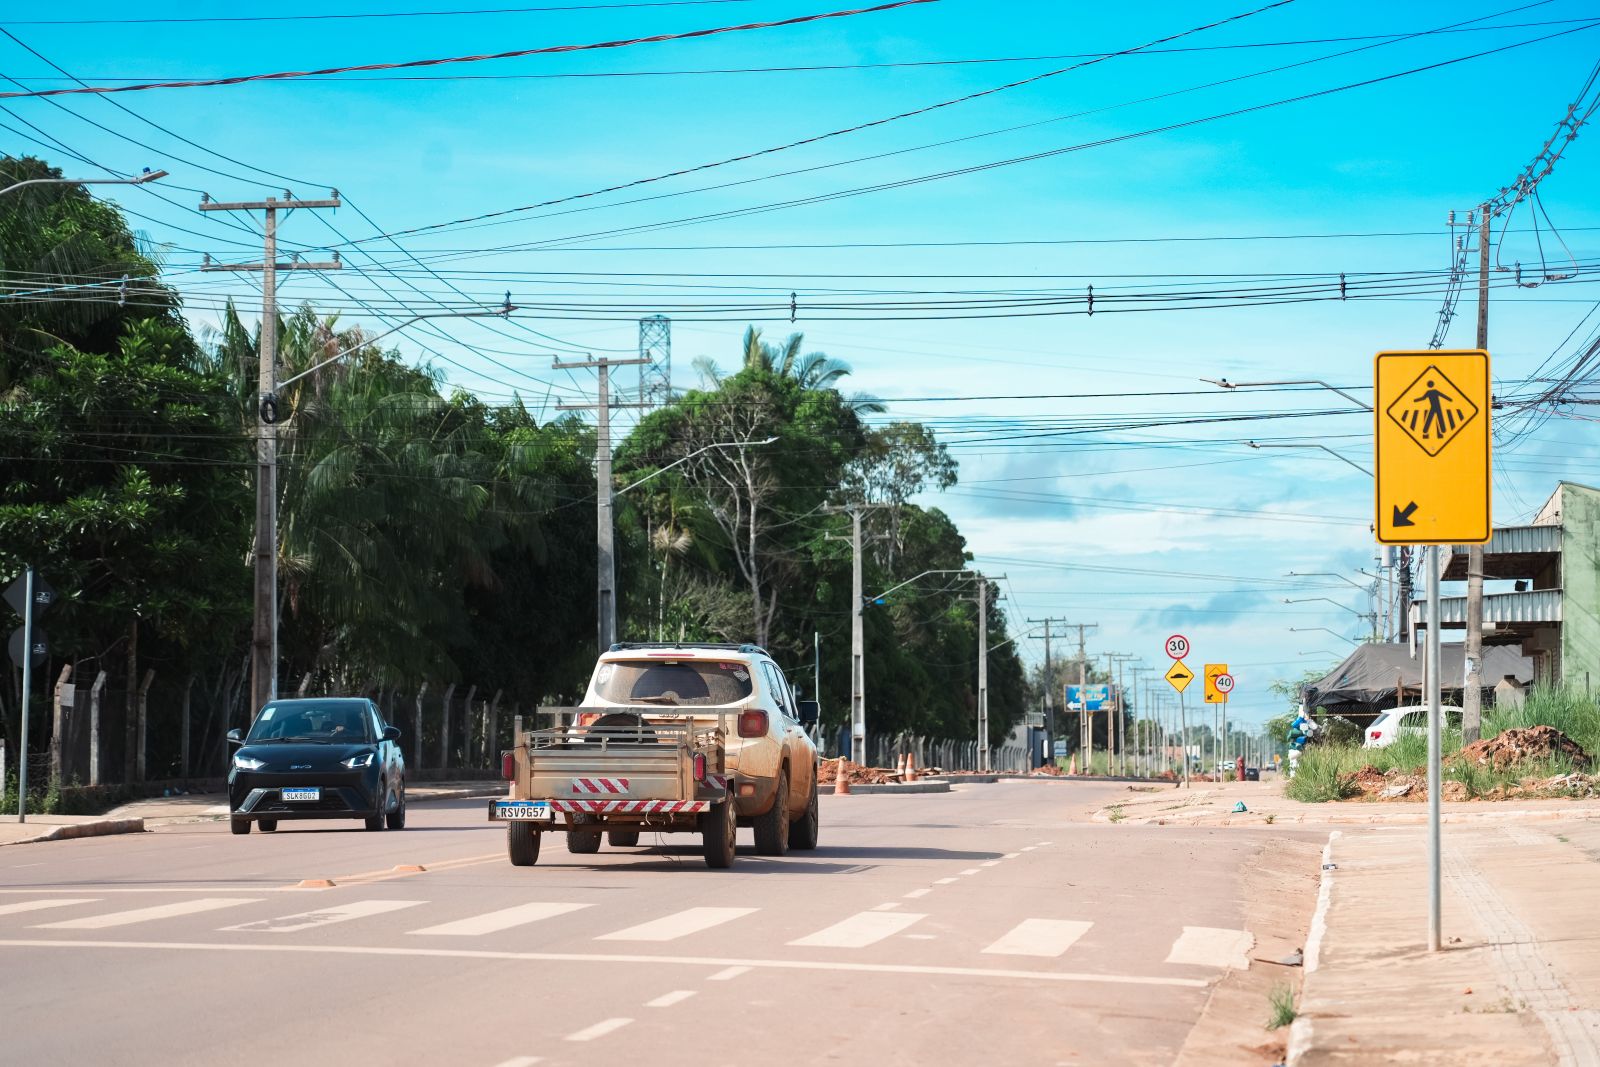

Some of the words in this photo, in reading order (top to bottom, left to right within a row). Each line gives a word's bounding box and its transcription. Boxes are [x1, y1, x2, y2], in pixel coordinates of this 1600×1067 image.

[1169, 640, 1185, 651] 30
[1218, 678, 1231, 687] 40
[501, 807, 545, 818] RSV9G57
